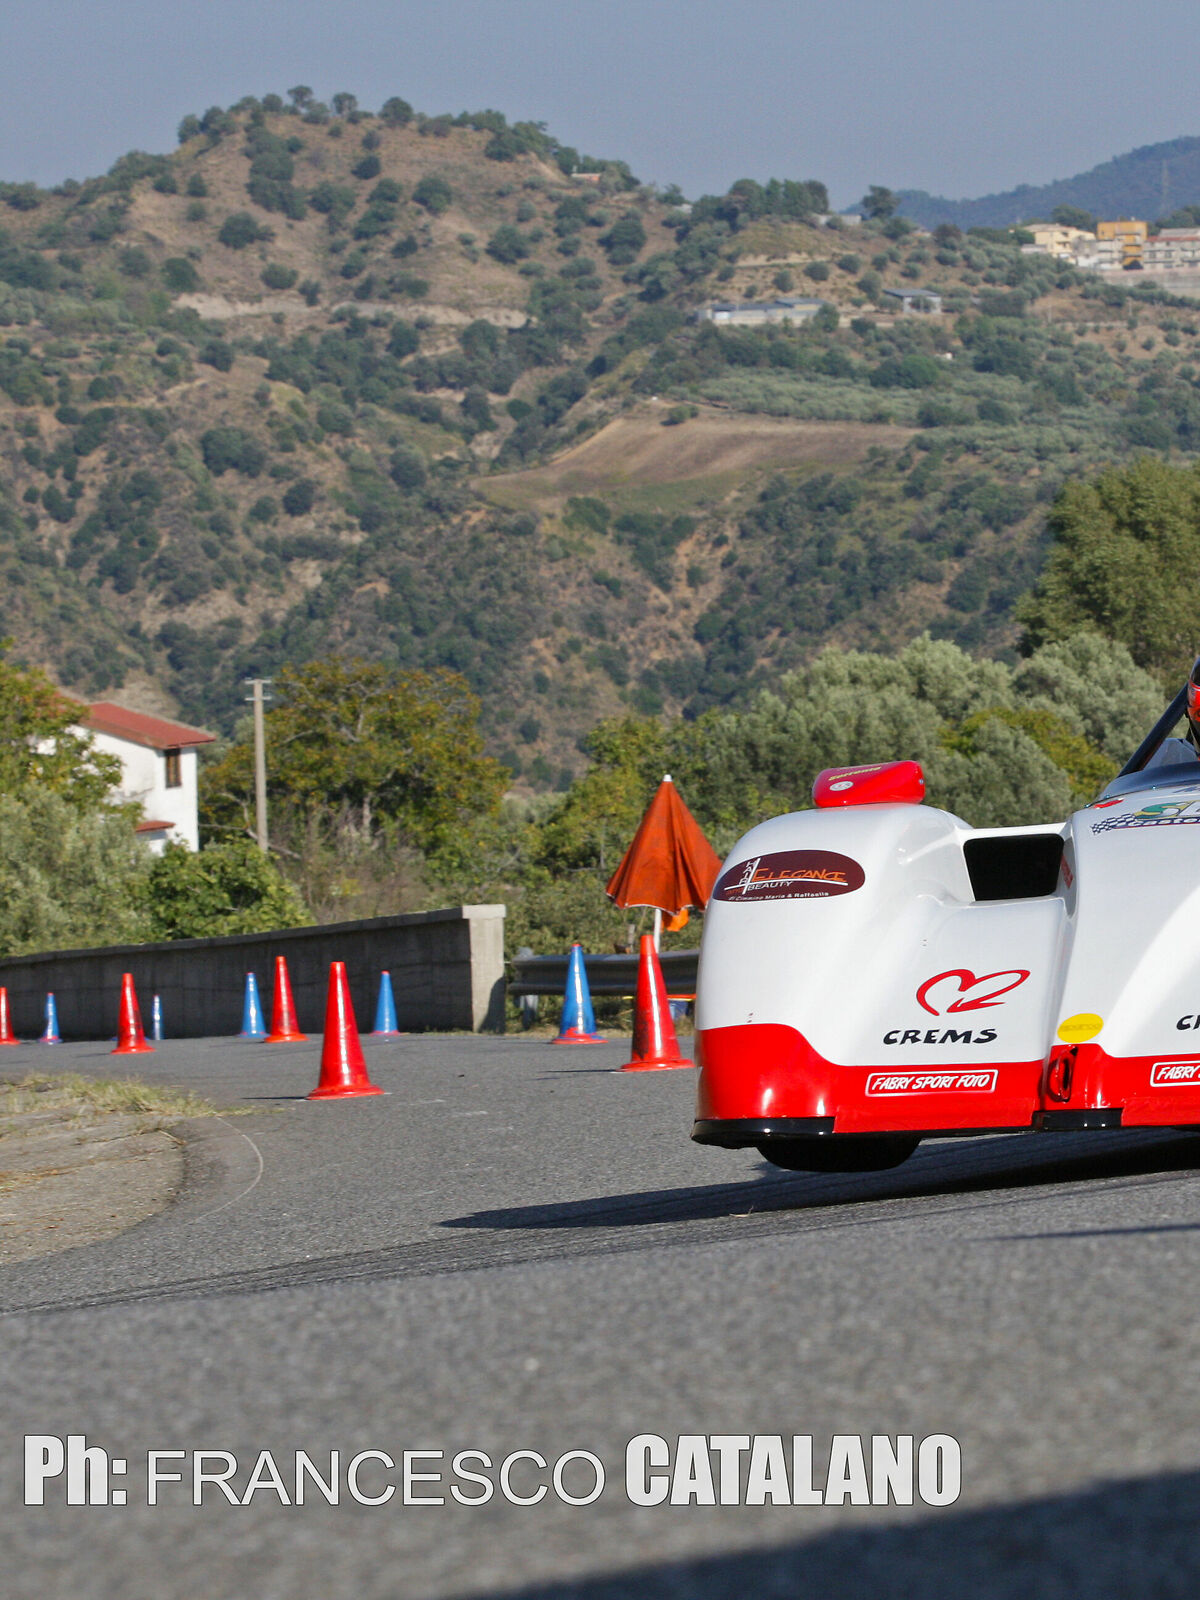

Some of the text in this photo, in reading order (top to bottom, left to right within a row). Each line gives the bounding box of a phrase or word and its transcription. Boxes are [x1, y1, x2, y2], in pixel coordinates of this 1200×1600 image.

[752, 868, 846, 882] ELEGANCE
[747, 881, 793, 891] BEAUTY
[883, 1028, 998, 1045] CREMS
[1156, 1066, 1200, 1081] FABRY
[871, 1074, 990, 1090] FABRY SPORT FOTO
